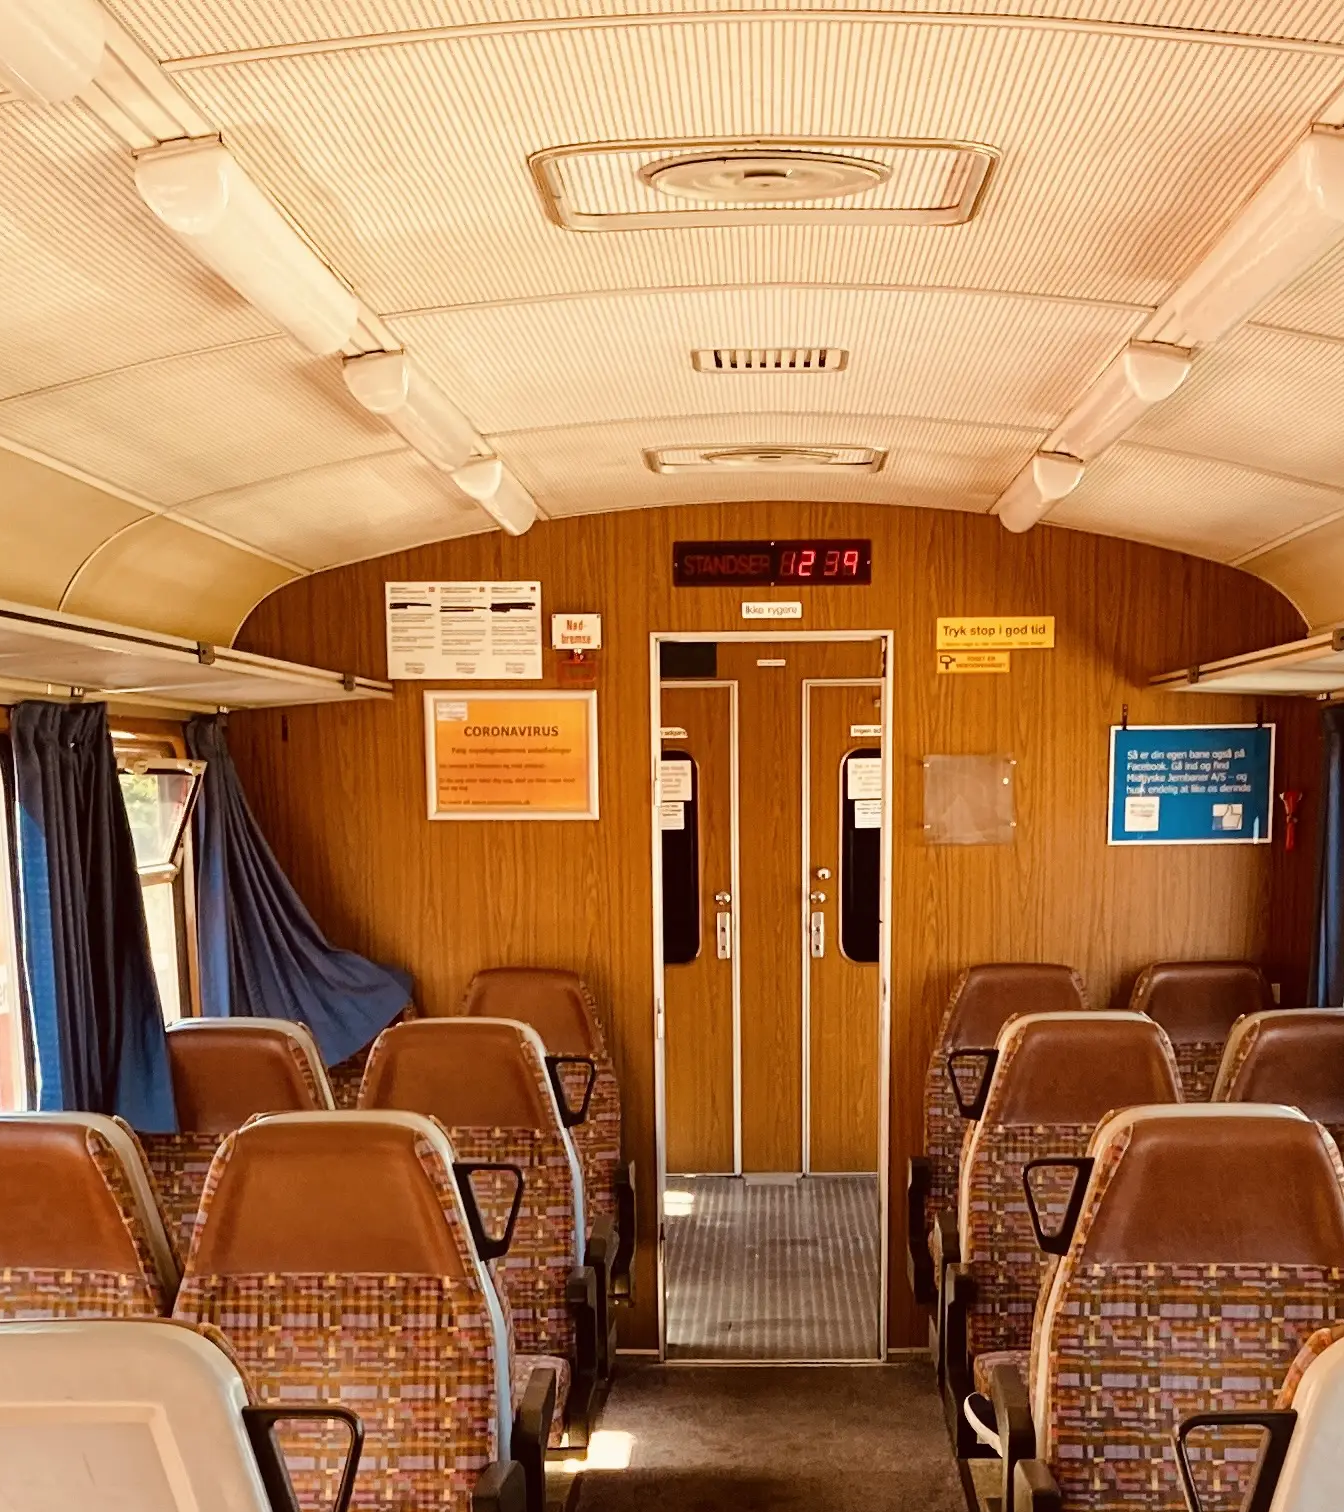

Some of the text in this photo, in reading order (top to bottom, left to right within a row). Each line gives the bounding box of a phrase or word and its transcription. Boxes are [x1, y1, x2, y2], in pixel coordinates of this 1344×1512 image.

[683, 555, 771, 576] STANDSER
[745, 604, 797, 616] Ikke rygere
[943, 625, 967, 638] Tryk
[970, 626, 996, 638] stop
[1005, 624, 1028, 637] god
[1031, 624, 1046, 635] tid
[561, 633, 592, 645] bremse
[464, 725, 560, 738] CORONAVIRUS
[1127, 748, 1246, 761] Så er din egen bane også på
[1127, 761, 1230, 772] Facebook. Gå ind og find
[1210, 772, 1227, 782] A/S
[1235, 773, 1248, 783] og
[1147, 785, 1178, 795] endelig
[1180, 785, 1190, 793] at
